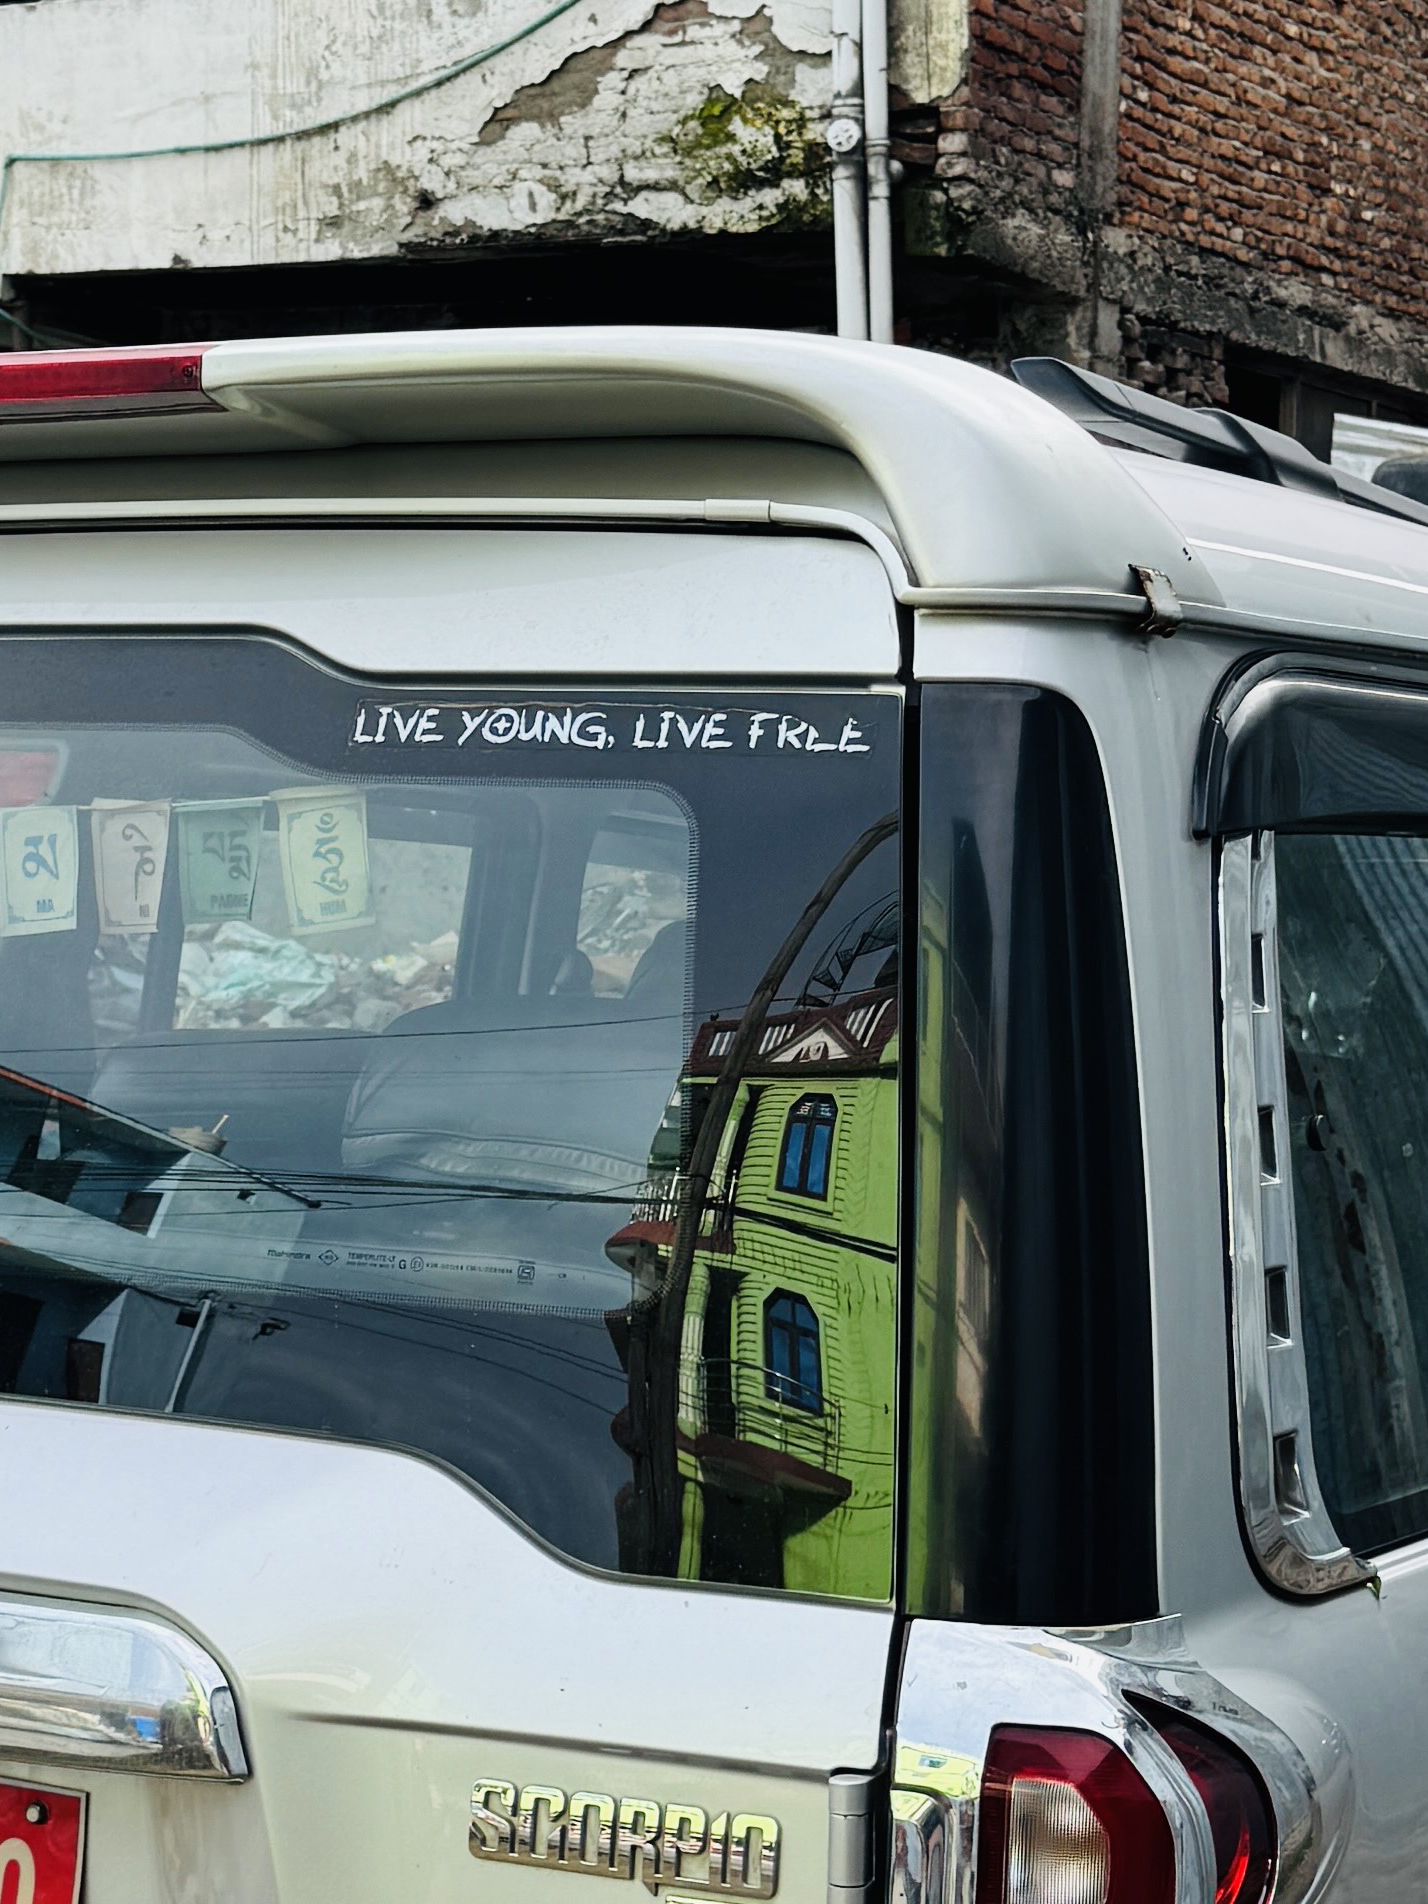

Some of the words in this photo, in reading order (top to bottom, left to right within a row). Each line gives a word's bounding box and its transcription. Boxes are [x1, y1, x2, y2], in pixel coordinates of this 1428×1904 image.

[353, 706, 444, 744] LIVE
[457, 706, 615, 750] YOUNG,
[632, 710, 733, 749] LIVE
[36, 899, 55, 914] MA
[469, 1777, 782, 1900] SCORPIO
